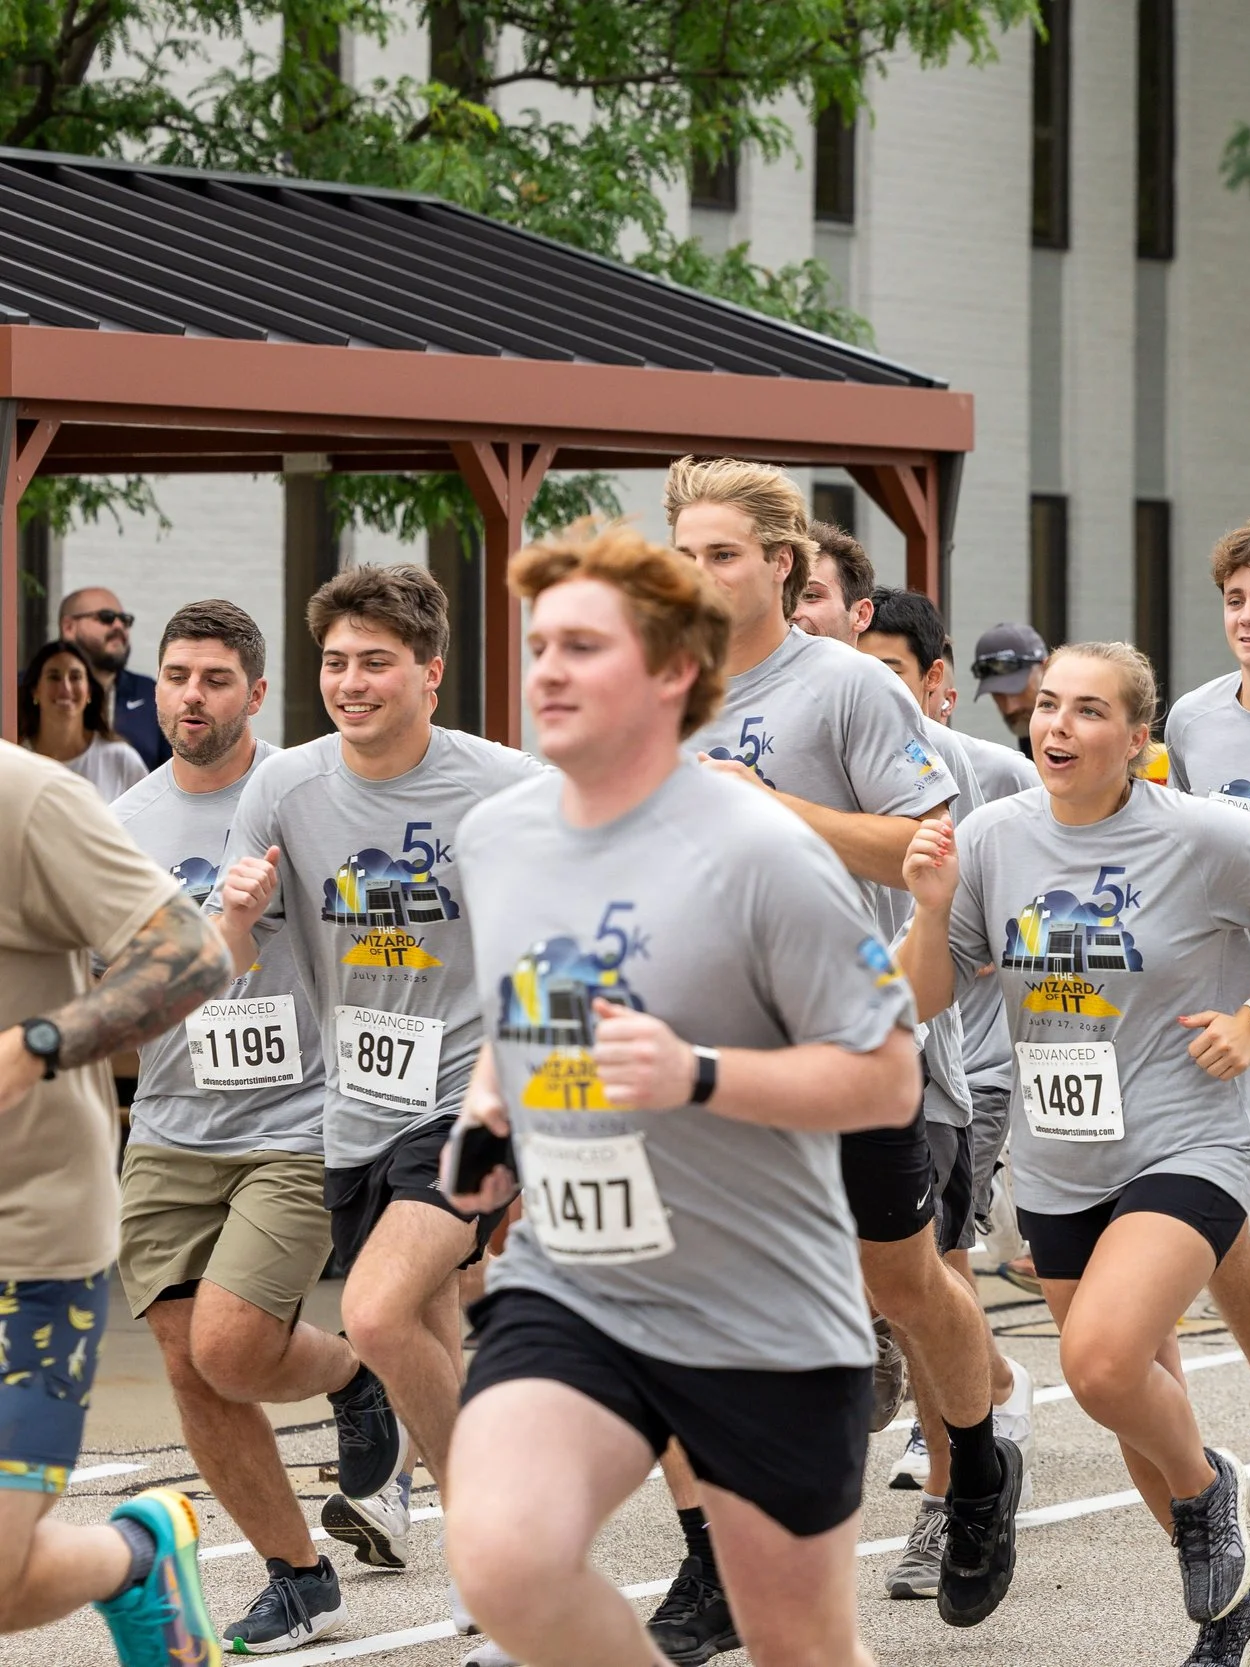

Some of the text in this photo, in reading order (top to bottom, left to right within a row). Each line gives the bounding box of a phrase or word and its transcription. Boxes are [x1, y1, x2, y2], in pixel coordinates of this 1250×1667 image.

[376, 925, 396, 935] THE
[351, 933, 425, 948] WIZARDS
[370, 947, 408, 967] OF IT
[352, 971, 377, 982] July
[1053, 971, 1075, 981] THE
[1025, 980, 1105, 996] WIZARDS
[202, 1002, 276, 1017] ADVANCED
[1045, 993, 1085, 1013] OF IT
[354, 1010, 424, 1032] ADVANCED
[1079, 1022, 1107, 1033] 2025
[206, 1025, 285, 1068] 1195
[1029, 1048, 1096, 1061] ADVANCED
[358, 1031, 415, 1080] 897
[202, 1073, 294, 1087] advancedsportstiming.com
[346, 1082, 427, 1107] advancedsportstiming.com
[1033, 1074, 1103, 1117] 1487
[542, 1177, 632, 1231] 1477
